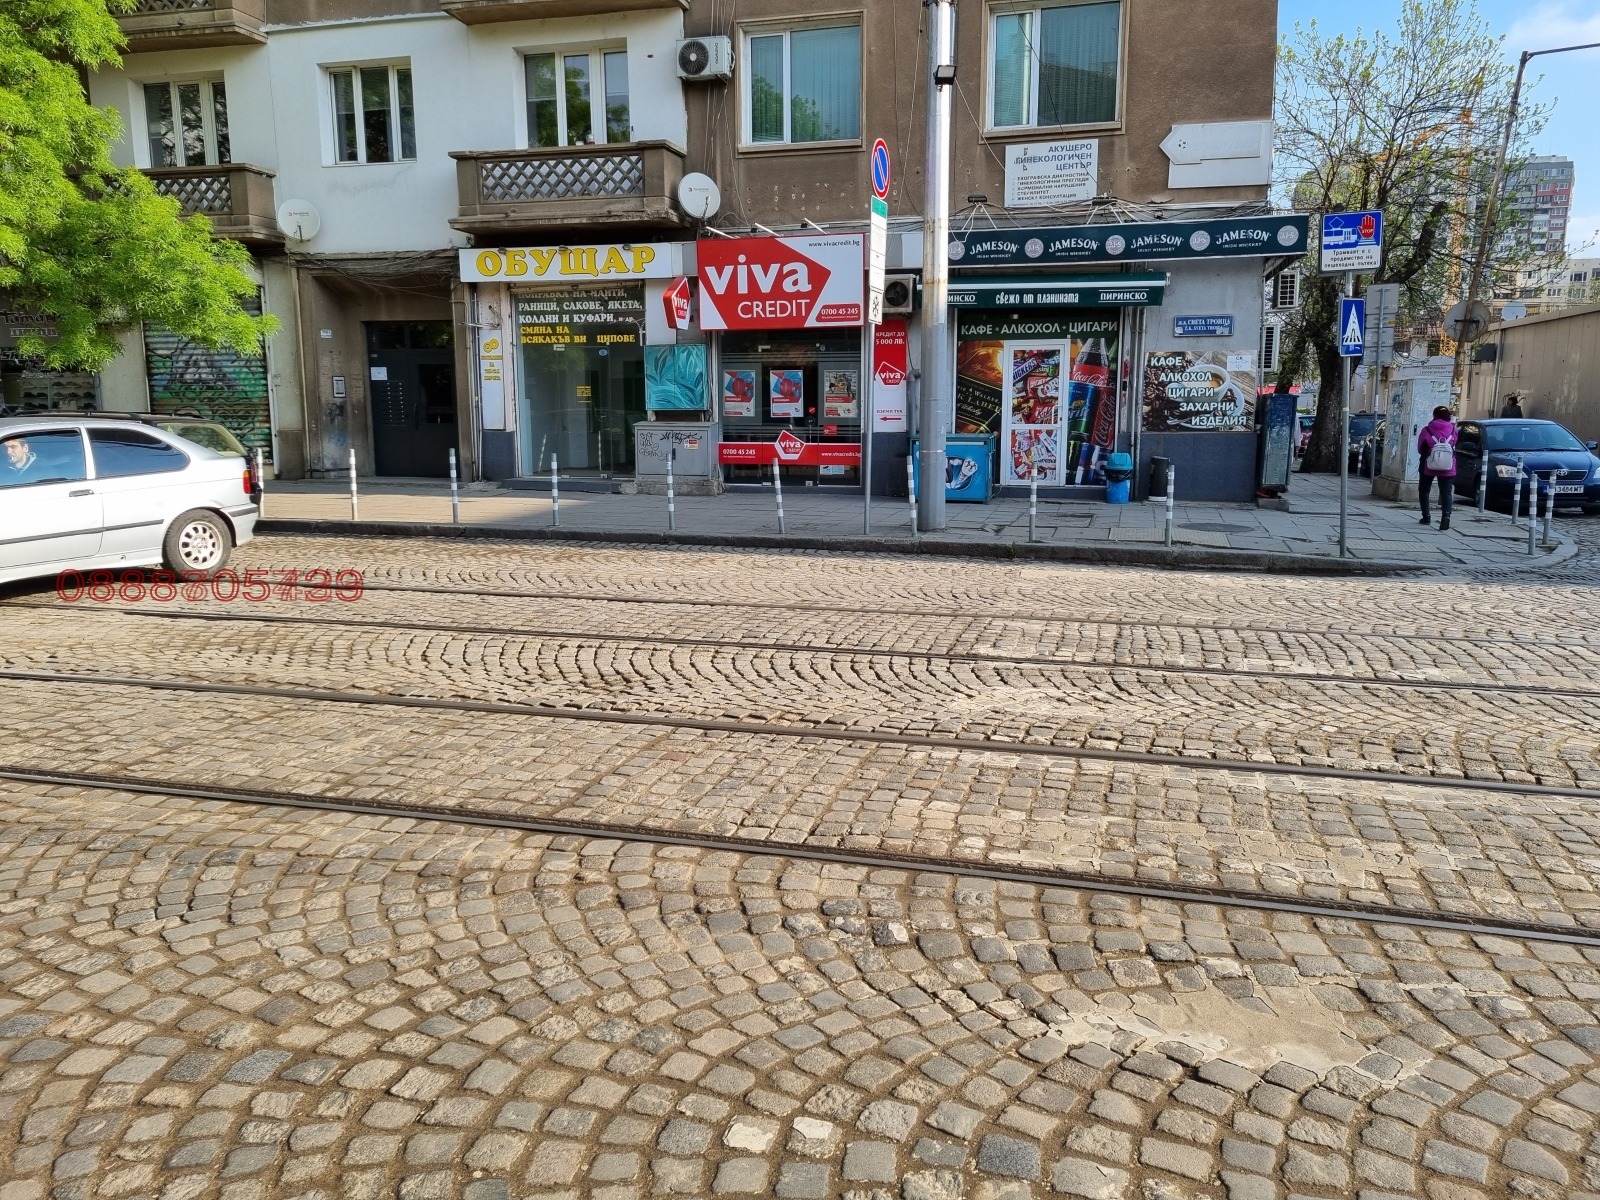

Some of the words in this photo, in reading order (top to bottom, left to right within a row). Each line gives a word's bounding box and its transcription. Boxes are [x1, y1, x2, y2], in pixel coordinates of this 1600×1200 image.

[1048, 143, 1092, 152] АКУШЕРО
[1016, 153, 1092, 164] ГИНЕКОЛОГИЧЕН
[1056, 162, 1092, 171] ЦЕНТЪР
[808, 239, 860, 247] www.vivacredit.bg
[1131, 234, 1182, 248] JAMESON
[1216, 230, 1270, 244] JAMESON
[970, 241, 1018, 254] JAMESON
[1049, 238, 1098, 252] JAMESON
[476, 246, 655, 277] ОБУЩАР
[704, 254, 812, 295] viva
[673, 294, 687, 309] viva
[948, 294, 976, 302] ИНСКО
[996, 292, 1019, 304] свежо
[1023, 293, 1034, 303] от
[1037, 292, 1079, 303] планината
[1100, 292, 1147, 300] ПИРИНСКО
[518, 303, 559, 311] РАНИЦИ,
[563, 301, 604, 311] САКОВЕ,
[608, 300, 643, 310] ЯКЕТА,
[738, 299, 810, 318] CREDIT
[518, 315, 558, 324] КОЛАНИ
[961, 324, 992, 335] КАФЕ
[1001, 322, 1060, 334] АЛКОХОЛ
[1069, 322, 1117, 334] ЦИГАРИ
[597, 335, 635, 343] ЦИПОВЕ
[1151, 356, 1182, 366] КАФЕ
[881, 371, 901, 379] viva
[1073, 371, 1105, 386] Coca-Cola
[1159, 372, 1212, 382] АЛКОХОЛ
[1168, 387, 1214, 399] ЦИГАРИ
[1179, 402, 1234, 411] ЗАХАРНИ
[1094, 393, 1116, 447] Coca-Cola
[1191, 416, 1247, 428] ИЗДЕЛИЯ
[781, 440, 801, 448] viva
